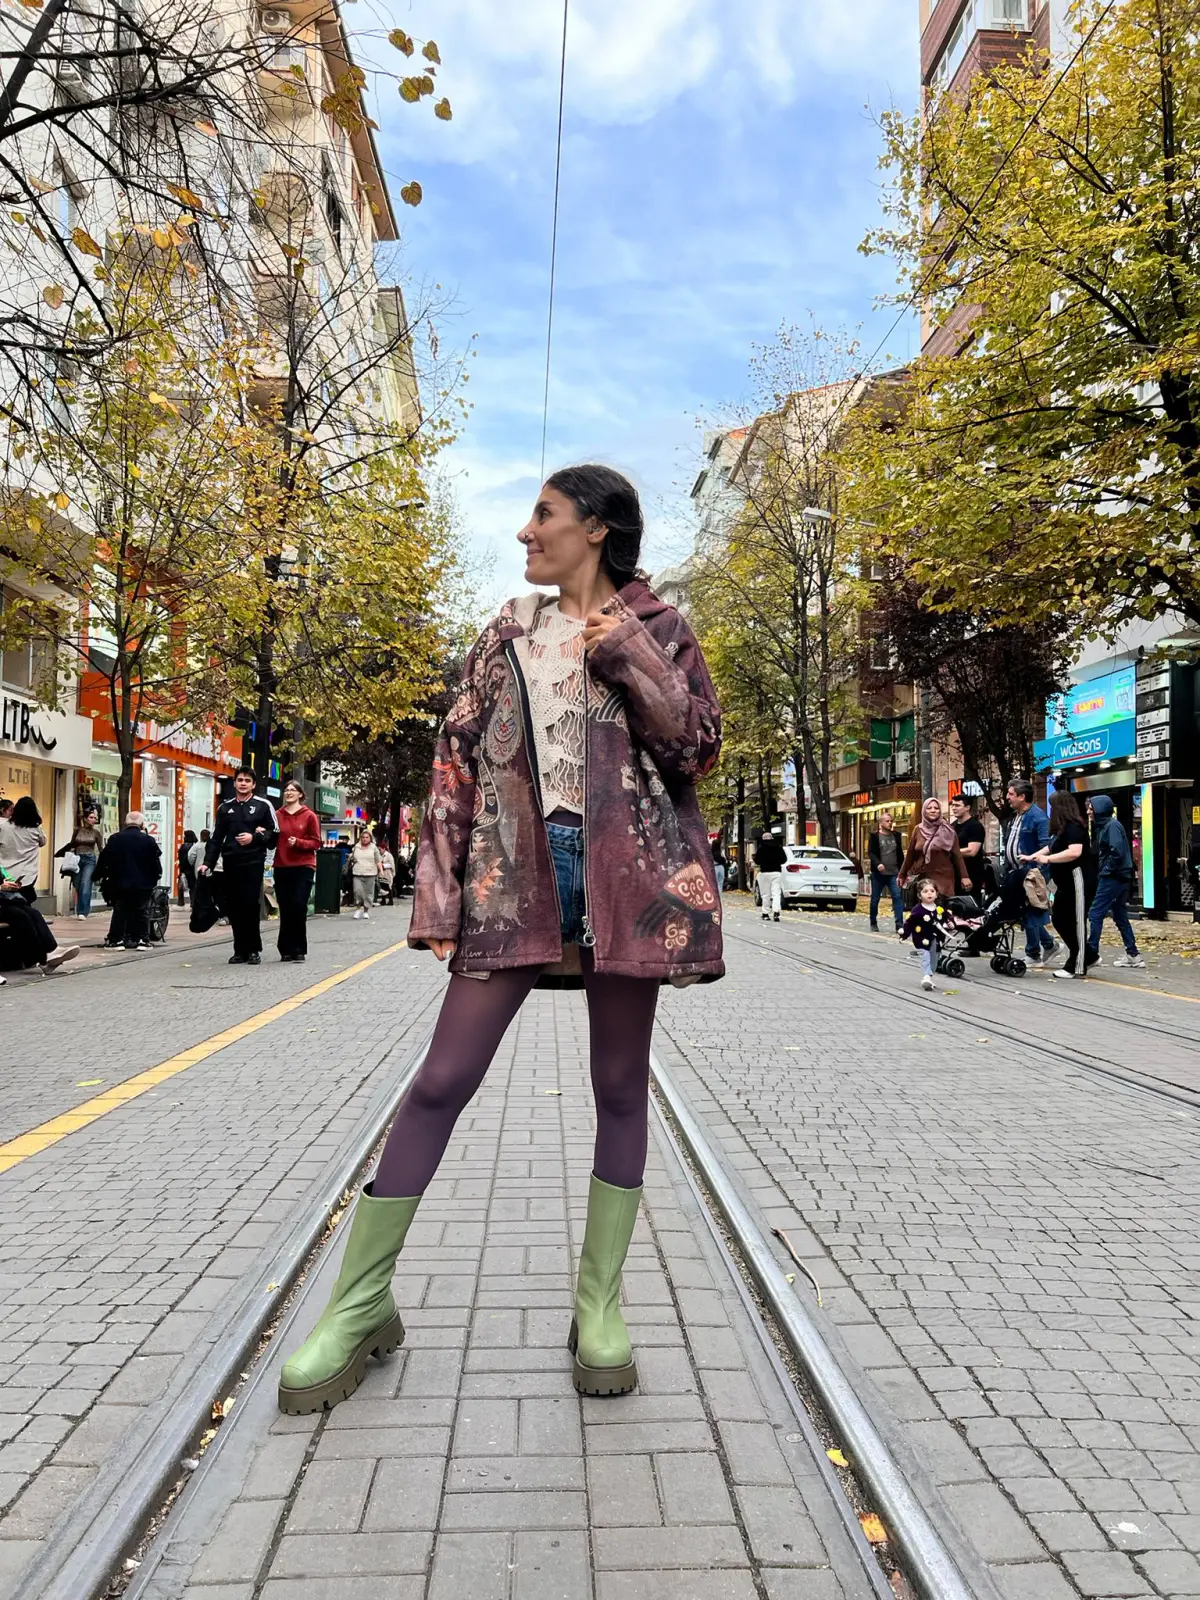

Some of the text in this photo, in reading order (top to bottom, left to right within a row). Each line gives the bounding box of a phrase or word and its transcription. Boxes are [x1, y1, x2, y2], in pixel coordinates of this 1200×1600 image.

[2, 696, 30, 744] LTB
[1060, 737, 1101, 757] watsons
[8, 767, 30, 785] LTB
